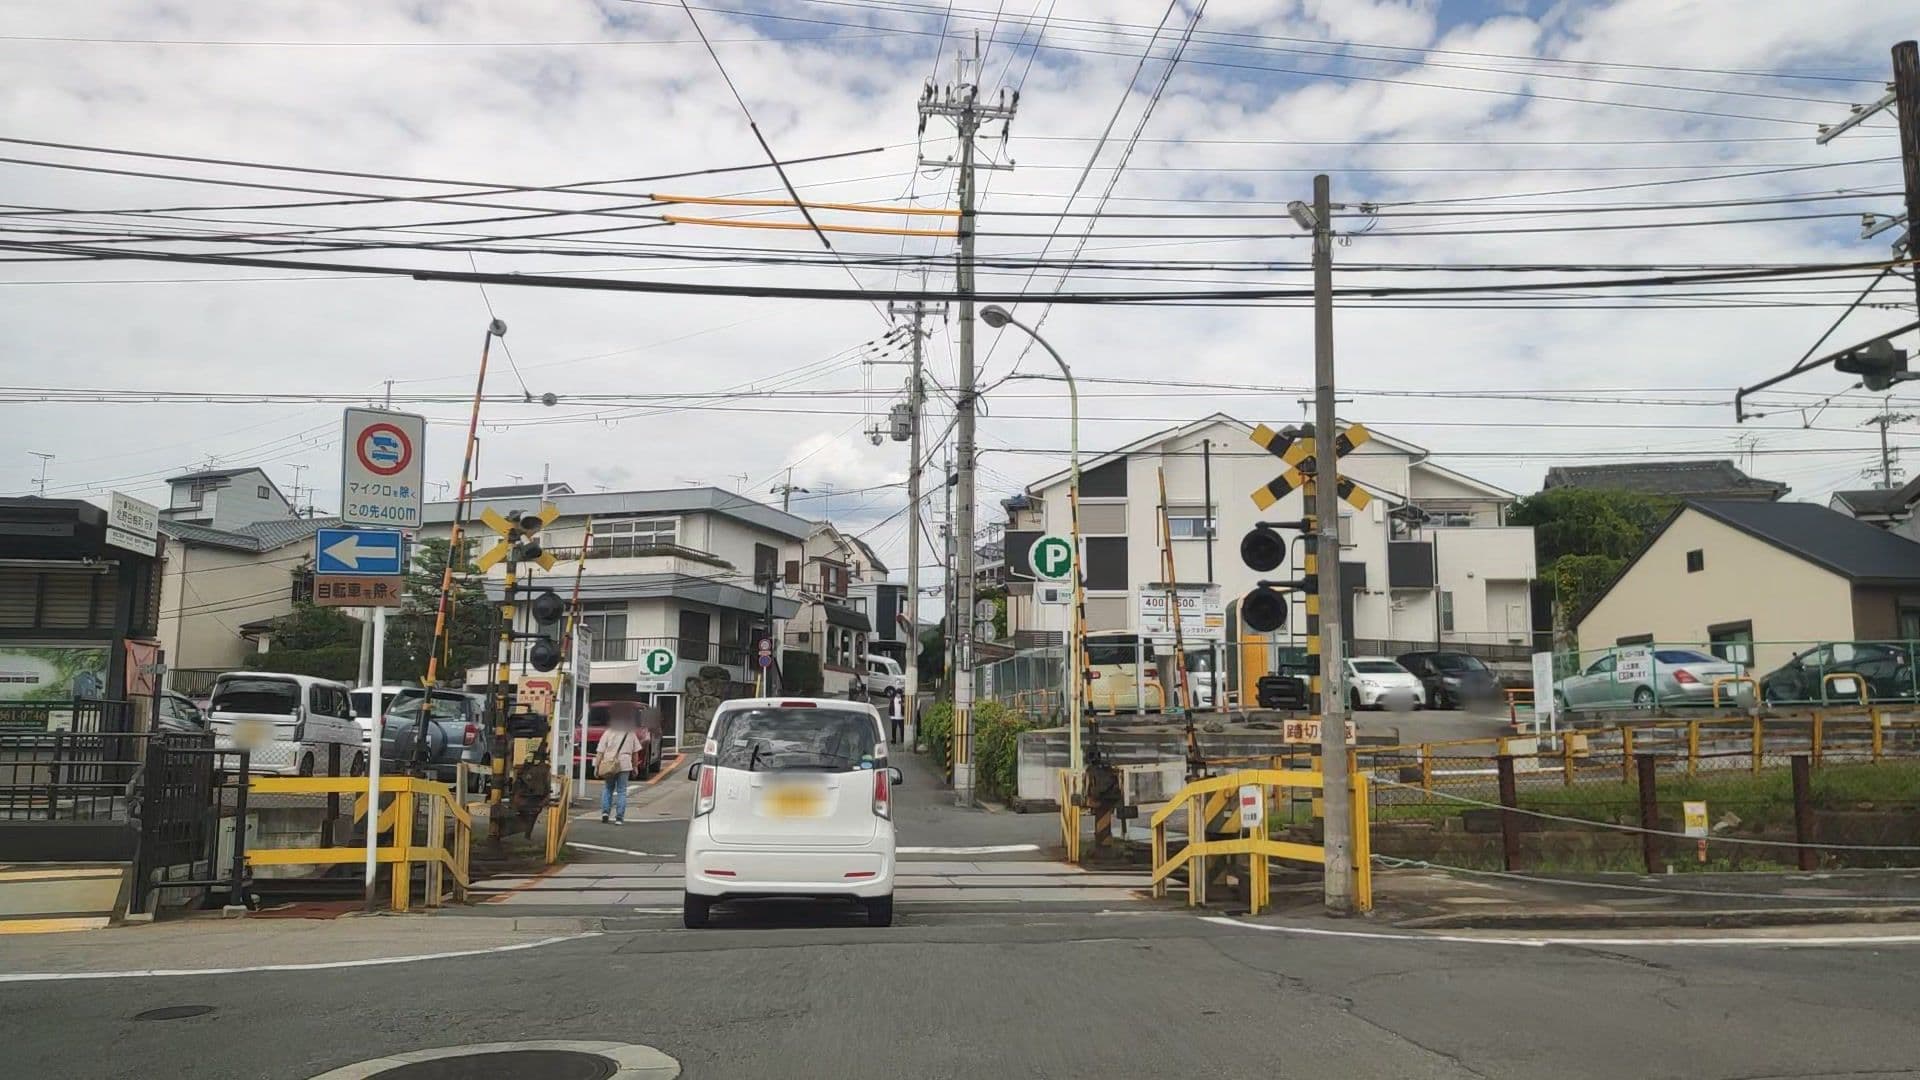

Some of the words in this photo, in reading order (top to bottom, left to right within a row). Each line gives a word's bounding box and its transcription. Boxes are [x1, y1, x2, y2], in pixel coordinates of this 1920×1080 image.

[349, 481, 416, 498] マイクロを除く
[348, 503, 416, 520] この先400m
[1046, 544, 1068, 572] P
[654, 652, 670, 672] P
